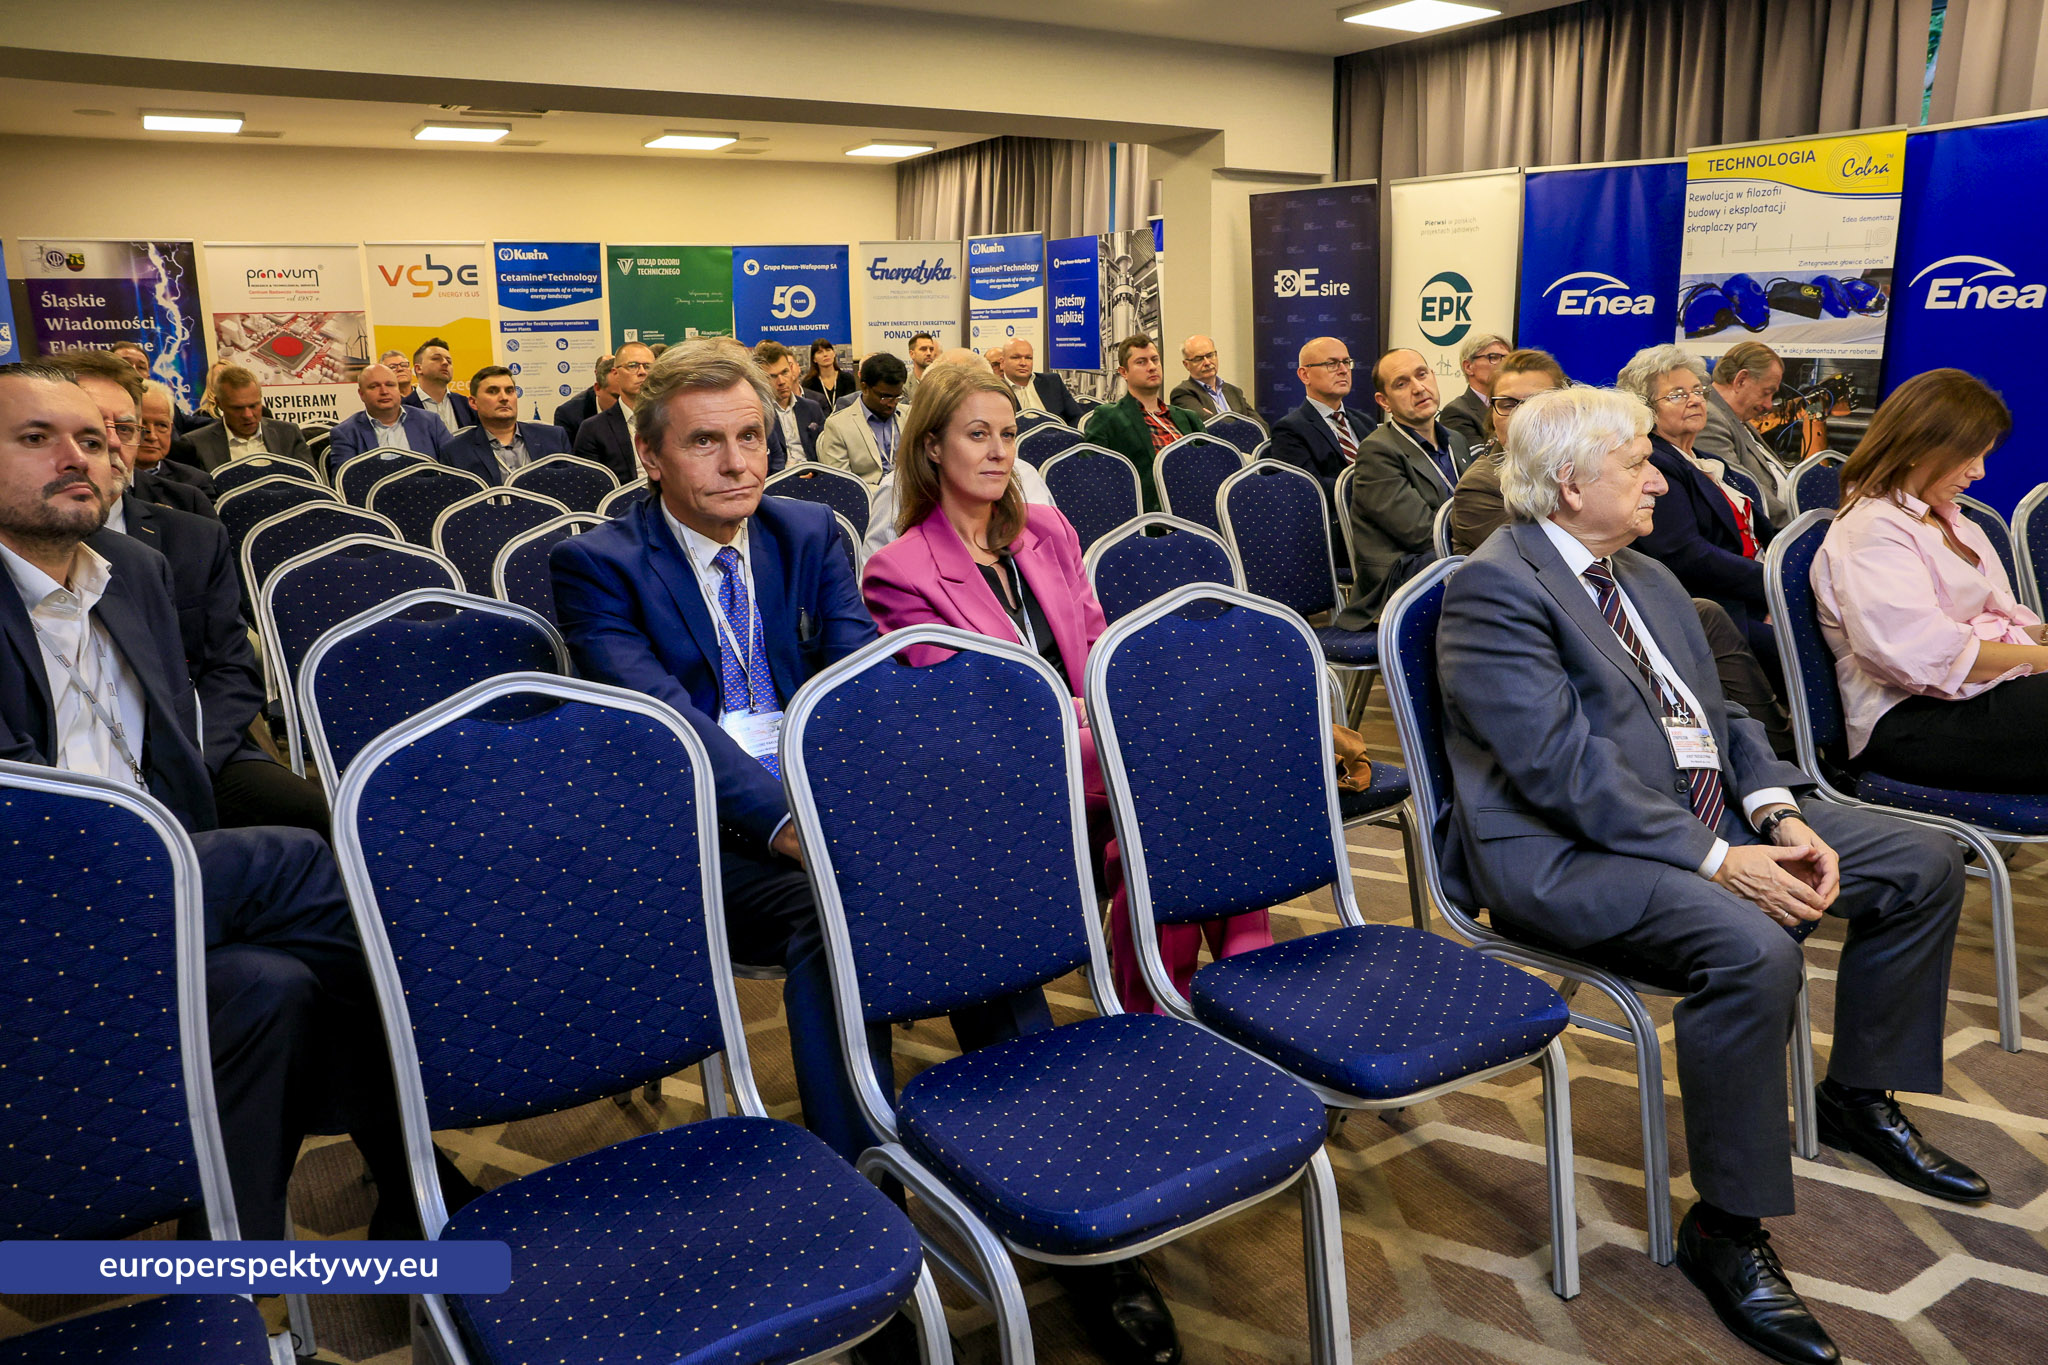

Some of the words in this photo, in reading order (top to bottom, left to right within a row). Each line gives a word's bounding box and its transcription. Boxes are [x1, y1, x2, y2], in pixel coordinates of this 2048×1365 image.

[1707, 150, 1816, 172] TECHNOLOGIA
[1842, 156, 1890, 177] Cobra
[1689, 190, 1734, 203] Rewolucja
[1746, 186, 1782, 198] filozofii
[1688, 207, 1720, 218] budowy
[1723, 206, 1727, 215] i
[1729, 201, 1786, 216] eksploatacji
[1687, 222, 1734, 234] skraplaczy
[1736, 222, 1758, 232] pary
[637, 259, 657, 267] URZĄD
[866, 257, 952, 285] Energetyka
[1003, 262, 1039, 272] Technology
[1798, 260, 1838, 268] Zintegrowane
[378, 254, 479, 298] vgbe
[547, 273, 598, 283] Technology
[41, 291, 106, 310] Śląskie
[771, 285, 816, 319] 50
[1055, 294, 1086, 309] Jesteśmy
[1557, 290, 1655, 315] Enea
[1925, 278, 2047, 310] Enea
[1421, 295, 1473, 322] EPK
[45, 316, 157, 331] Wiadomości
[1055, 311, 1084, 326] najbliżej
[884, 331, 912, 339] PONAD
[264, 394, 336, 408] WSPIERAMY
